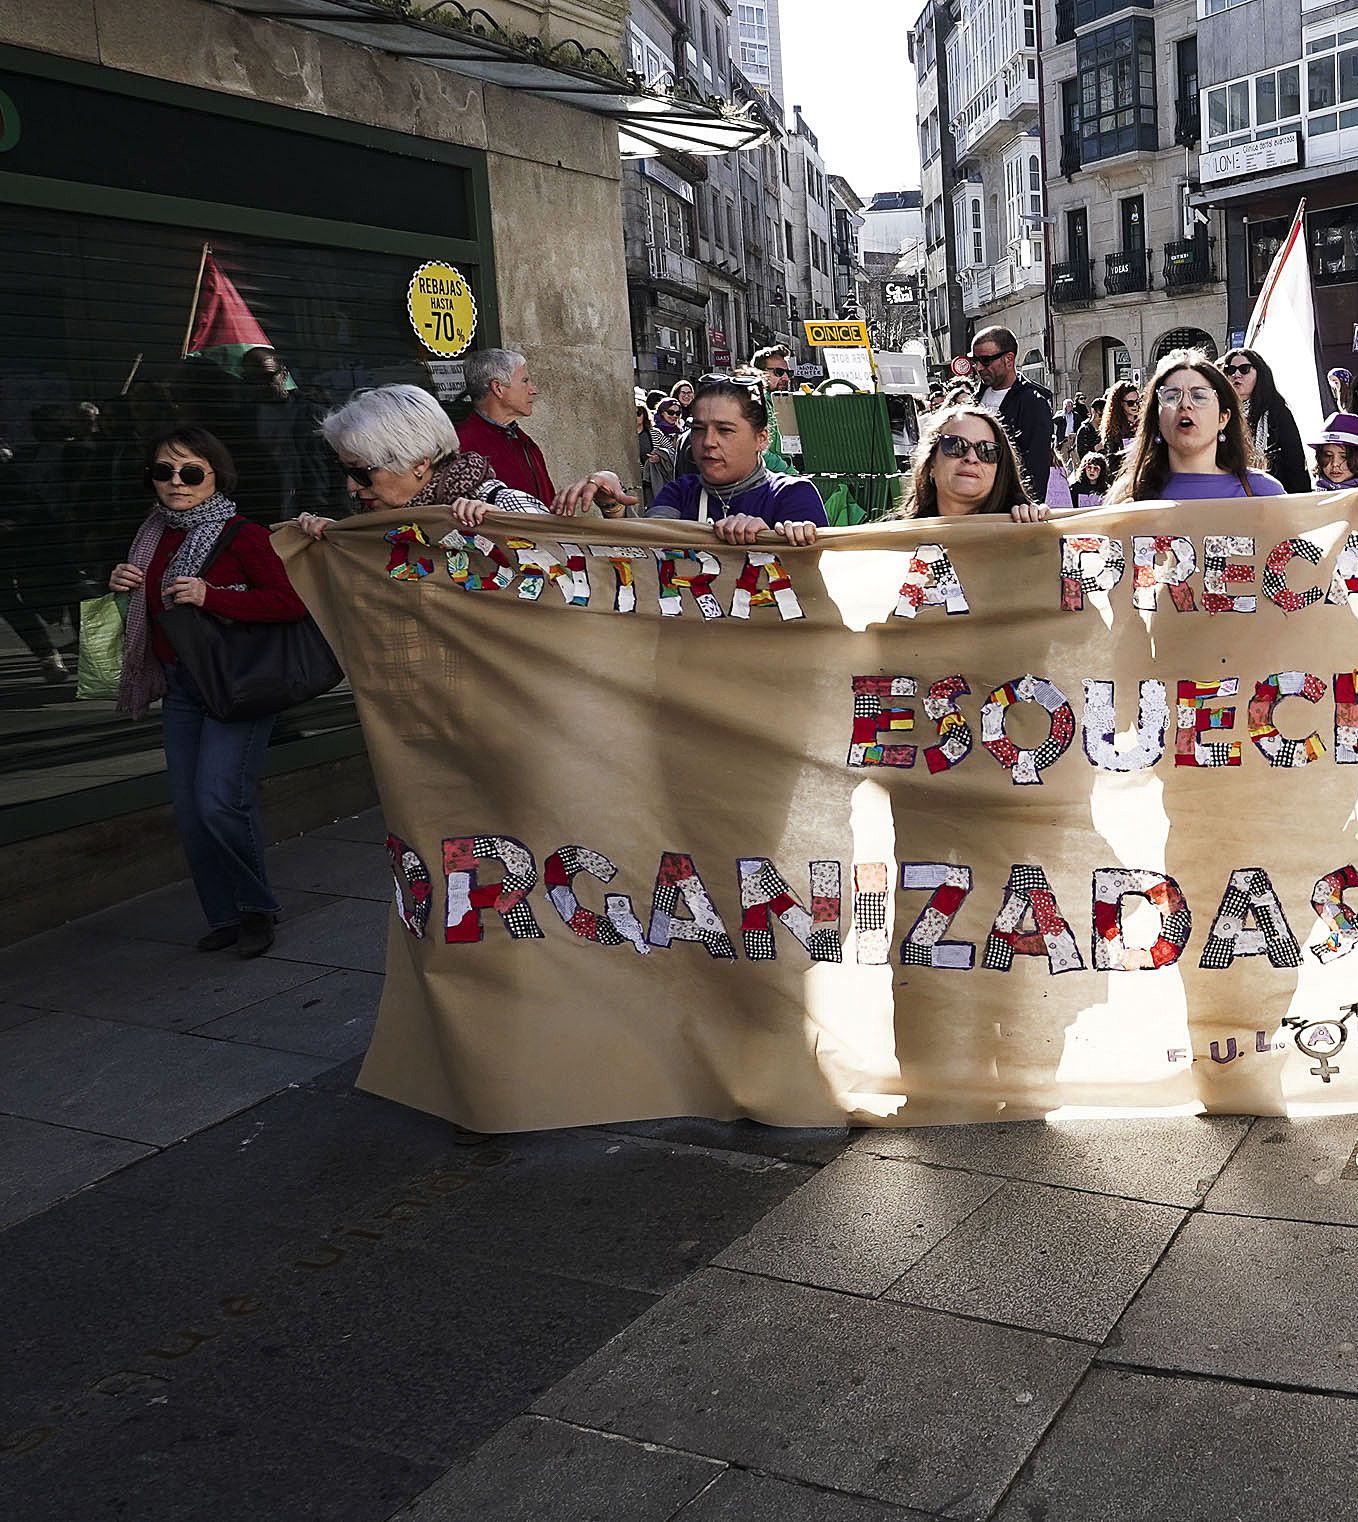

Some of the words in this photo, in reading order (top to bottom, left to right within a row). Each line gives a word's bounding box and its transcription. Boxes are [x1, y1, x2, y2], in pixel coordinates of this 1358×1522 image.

[418, 277, 462, 297] REBAJAS
[430, 297, 455, 310] HASTA
[811, 326, 862, 341] ONCE
[385, 522, 805, 621] CONTRA
[892, 543, 970, 618] A
